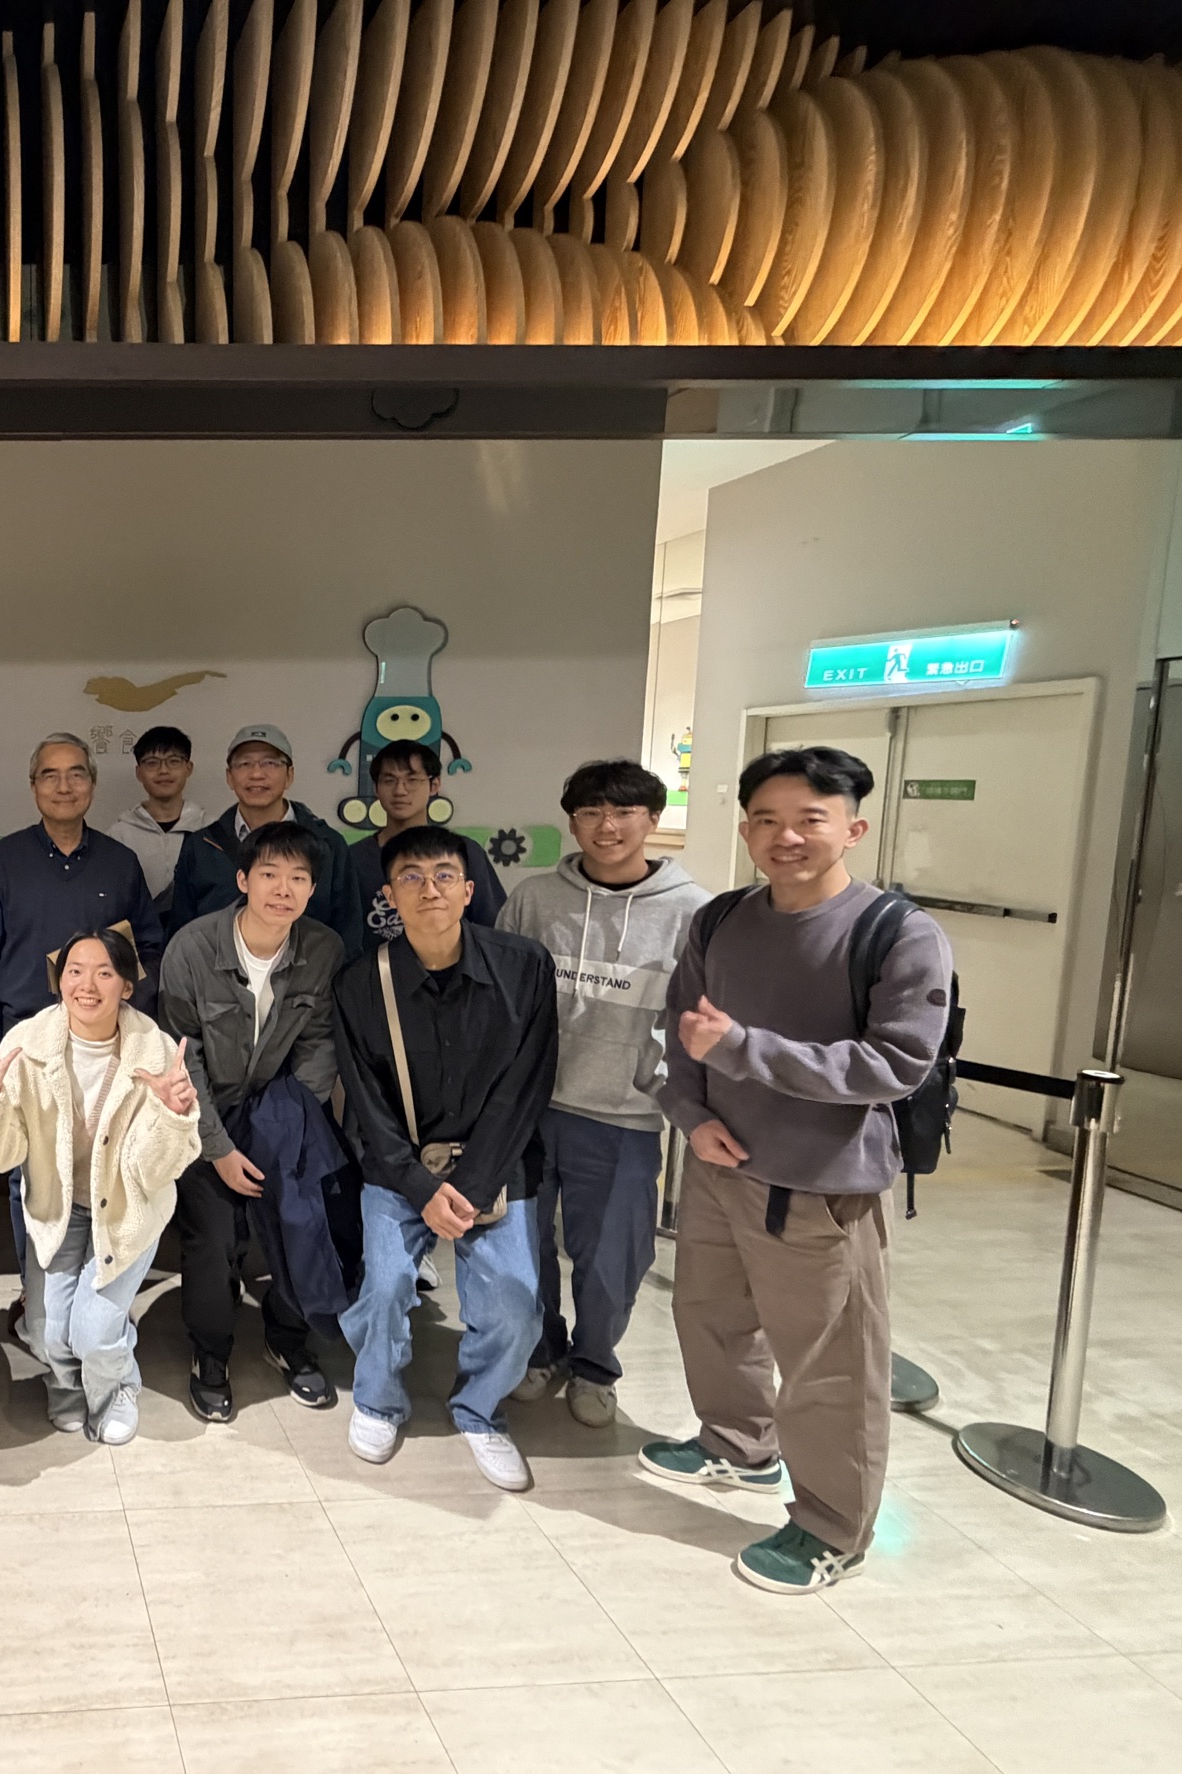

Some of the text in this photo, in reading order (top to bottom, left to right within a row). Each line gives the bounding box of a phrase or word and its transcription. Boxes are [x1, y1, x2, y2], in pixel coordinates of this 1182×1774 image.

[823, 668, 868, 681] EXIT
[926, 660, 985, 675] 緊急出口
[556, 968, 631, 990] UNDERSTAND
